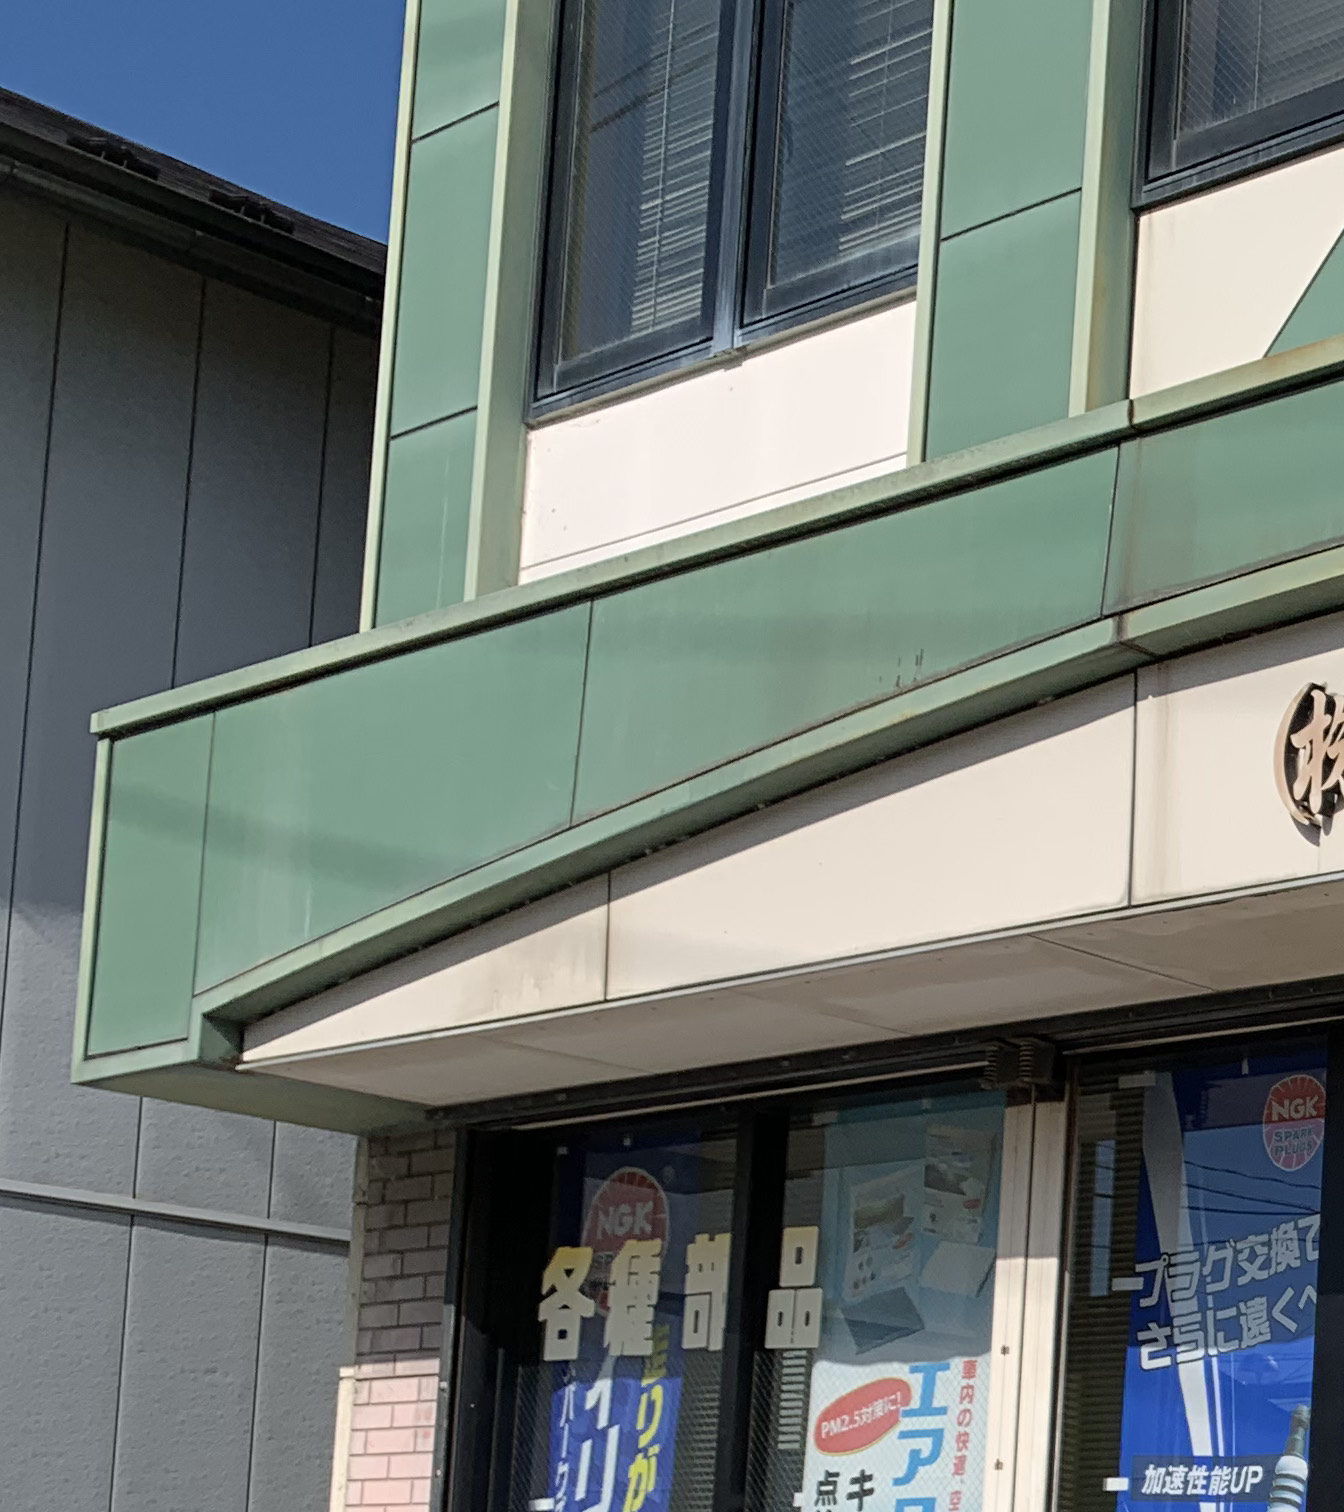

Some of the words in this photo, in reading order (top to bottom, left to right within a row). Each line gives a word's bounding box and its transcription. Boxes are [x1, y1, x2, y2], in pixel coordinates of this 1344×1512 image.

[1271, 1095, 1318, 1121] NGK
[1274, 1127, 1312, 1143] SPARK
[597, 1201, 655, 1236] NGK
[1142, 1464, 1263, 1496] 加速性能UP
